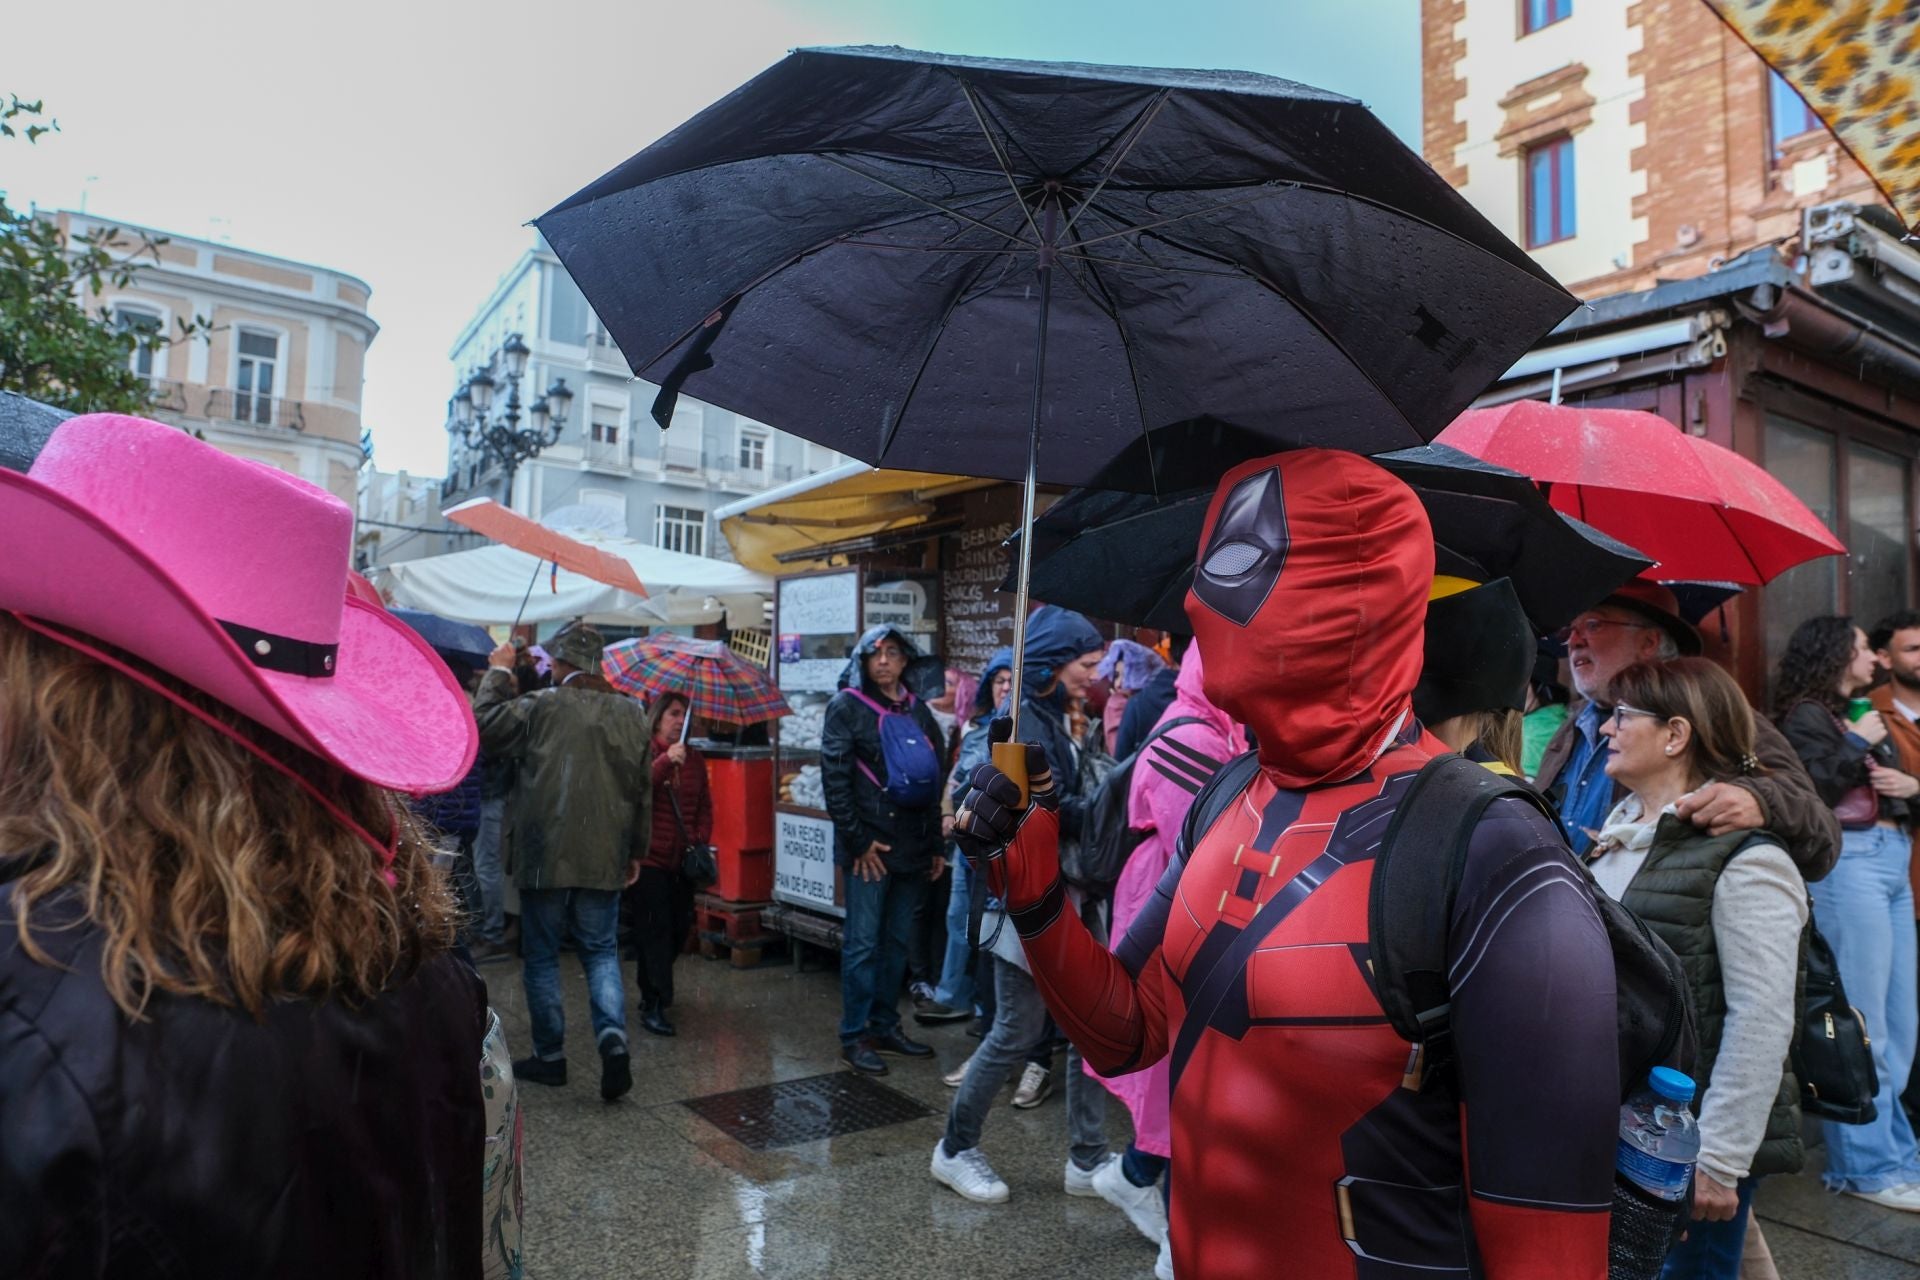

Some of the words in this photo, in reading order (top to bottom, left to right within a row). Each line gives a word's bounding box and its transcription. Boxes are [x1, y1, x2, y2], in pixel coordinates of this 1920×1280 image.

[961, 523, 1012, 550] BEBIDAS
[956, 547, 1007, 568] DRINKS
[944, 584, 983, 601] SNACKS
[945, 600, 999, 617] SANDWICH
[782, 822, 797, 838] PAN
[799, 823, 826, 844] RECIÉN
[784, 839, 826, 863] HORNEADO
[800, 860, 806, 876] Y
[776, 872, 790, 889] PAN
[792, 876, 801, 893] DE
[803, 878, 834, 901] PUEBLO
